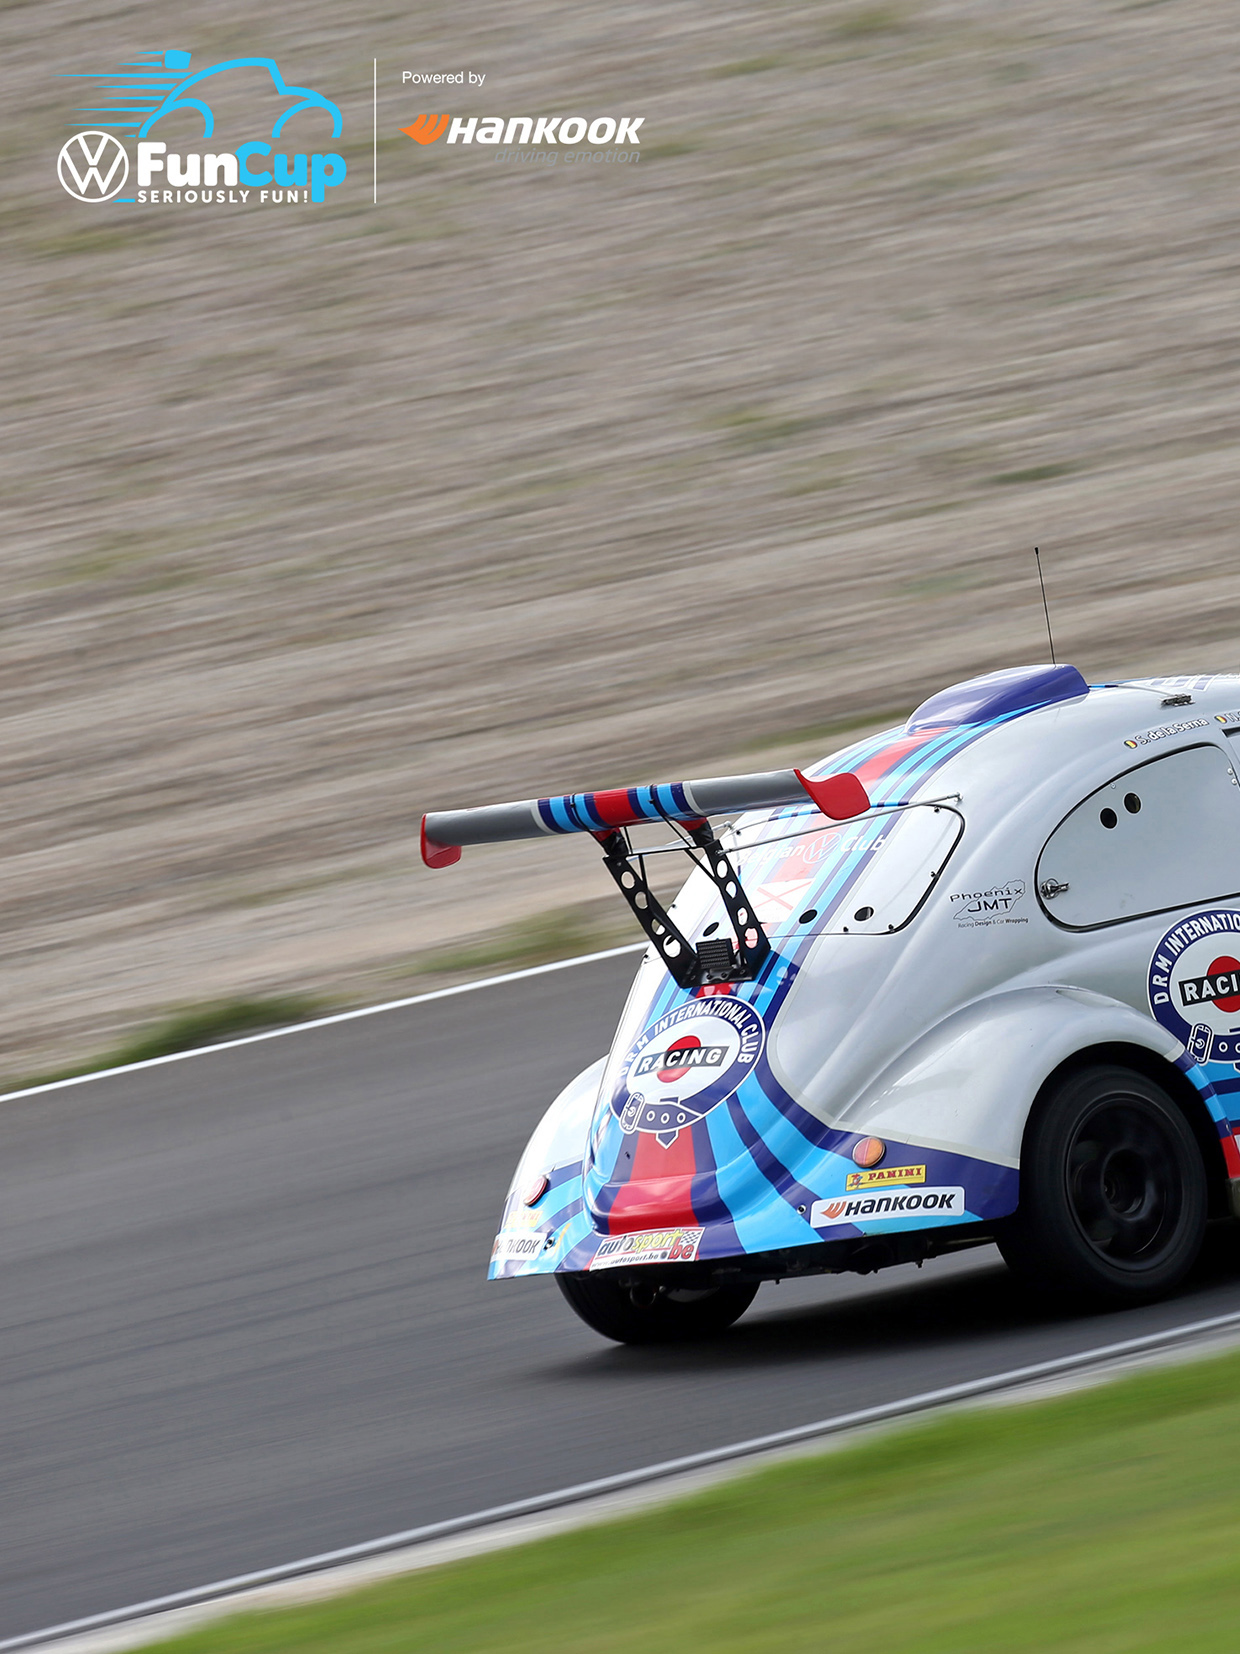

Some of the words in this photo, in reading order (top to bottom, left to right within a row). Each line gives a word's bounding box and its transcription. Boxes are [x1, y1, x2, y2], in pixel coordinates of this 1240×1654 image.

[1172, 718, 1210, 733] Serna
[839, 835, 886, 851] Club
[949, 887, 1023, 902] Phoenix
[967, 898, 1012, 912] JMT
[654, 1000, 752, 1036] INTERNATIONAL
[736, 1023, 760, 1064] CLUB
[638, 1048, 724, 1073] RACING
[868, 1167, 922, 1181] PANINI
